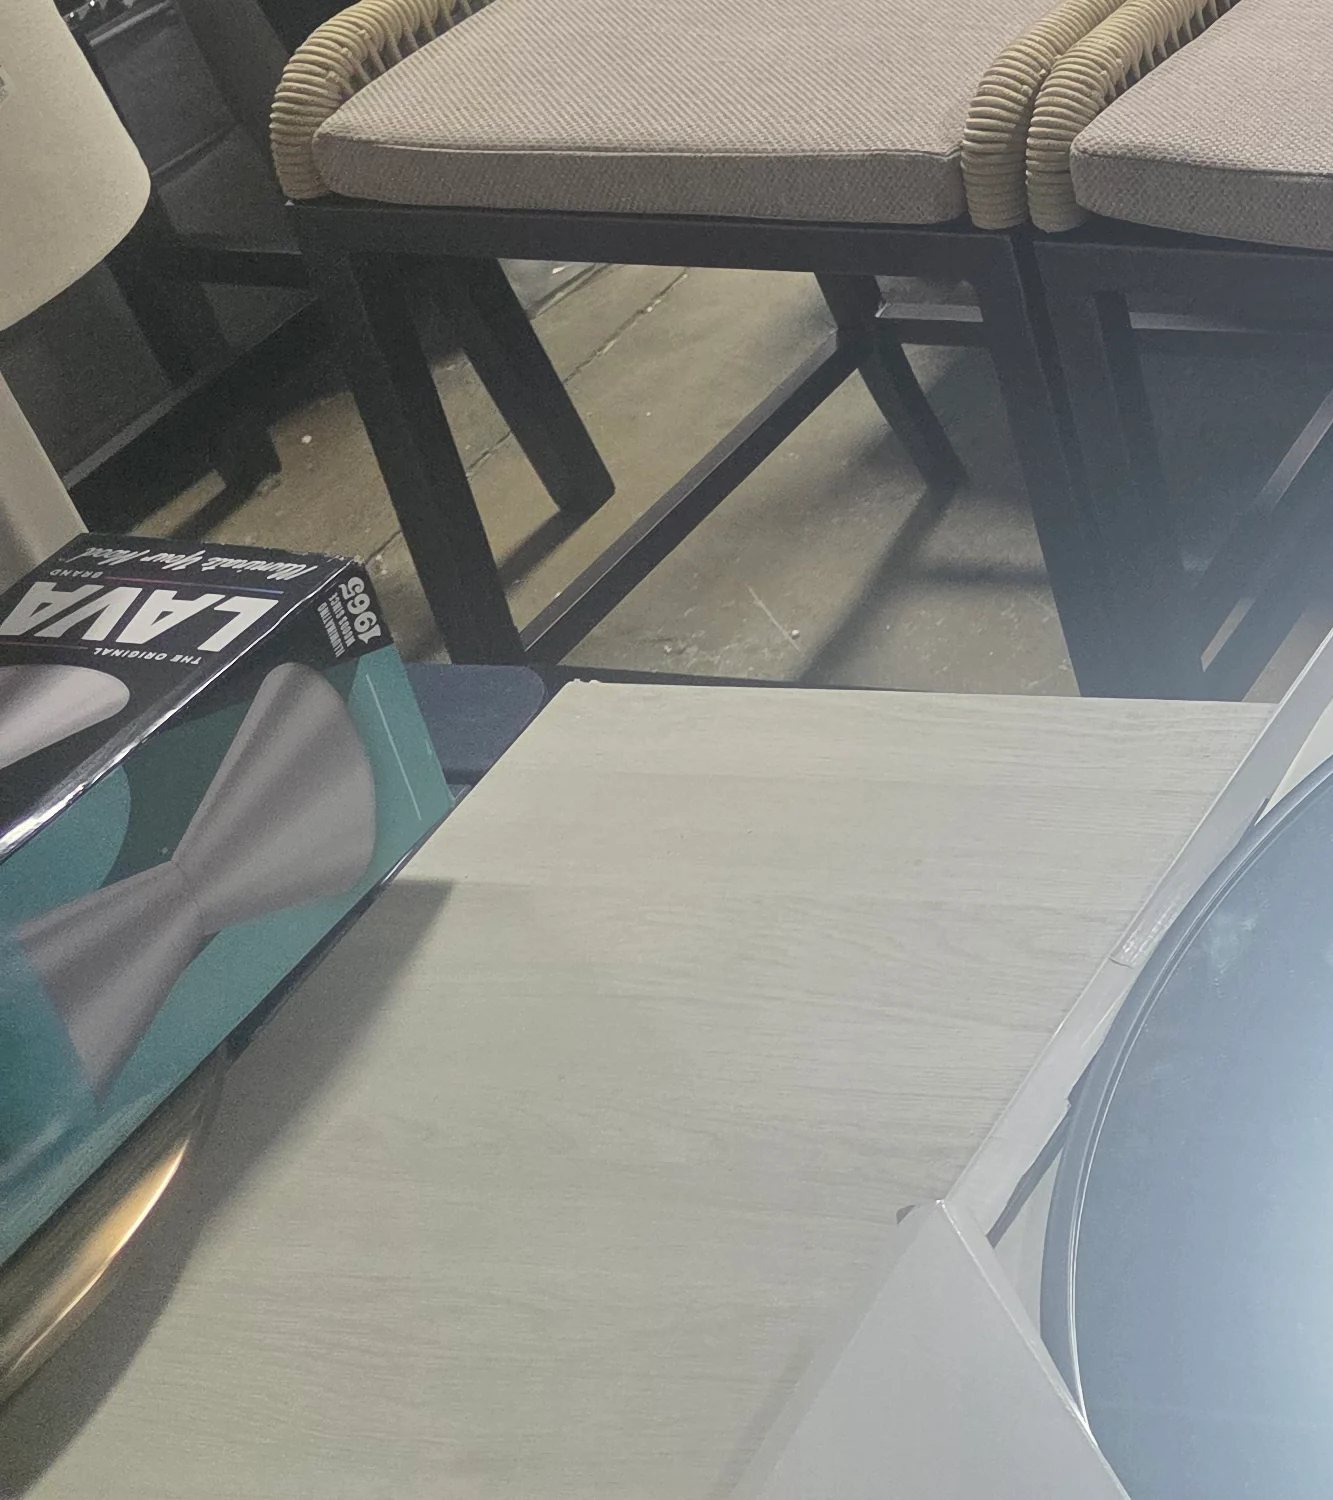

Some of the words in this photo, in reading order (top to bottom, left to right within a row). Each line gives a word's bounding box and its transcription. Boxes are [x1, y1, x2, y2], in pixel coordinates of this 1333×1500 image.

[142, 548, 206, 572] Your
[49, 568, 104, 579] BRAND
[0, 581, 279, 652] LAVA
[338, 576, 382, 644] 1965
[93, 647, 167, 663] ORIGINAL
[169, 653, 203, 666] THE
